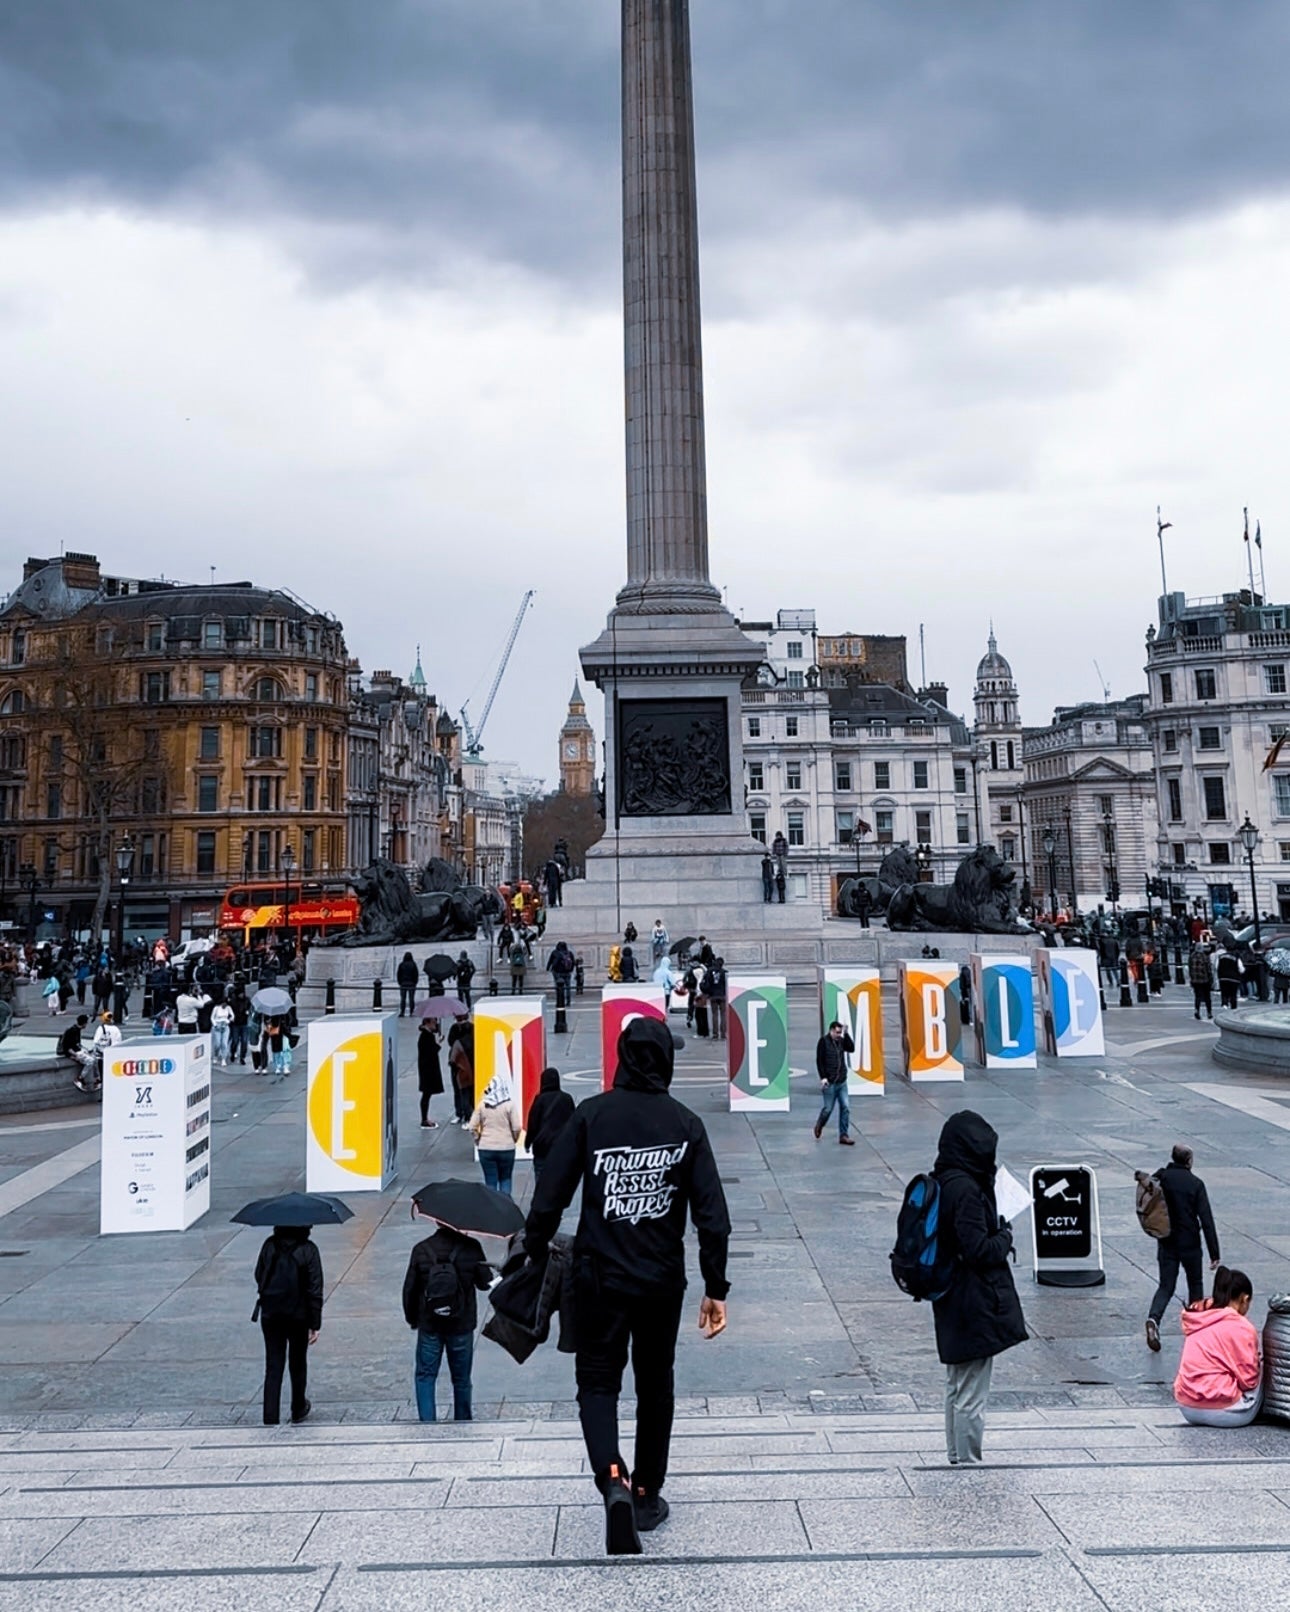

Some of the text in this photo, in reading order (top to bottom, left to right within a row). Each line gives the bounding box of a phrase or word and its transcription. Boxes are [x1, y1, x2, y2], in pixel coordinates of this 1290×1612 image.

[331, 1051, 358, 1161] E
[747, 1000, 769, 1086] E
[836, 991, 872, 1071] M
[922, 983, 947, 1059] B
[998, 976, 1019, 1047] L
[1067, 970, 1088, 1037] E
[593, 1141, 689, 1176] Forward
[604, 1167, 671, 1196] Assist
[603, 1185, 679, 1225] Project
[1046, 1217, 1078, 1226] CCTV
[1050, 1229, 1083, 1237] operation
